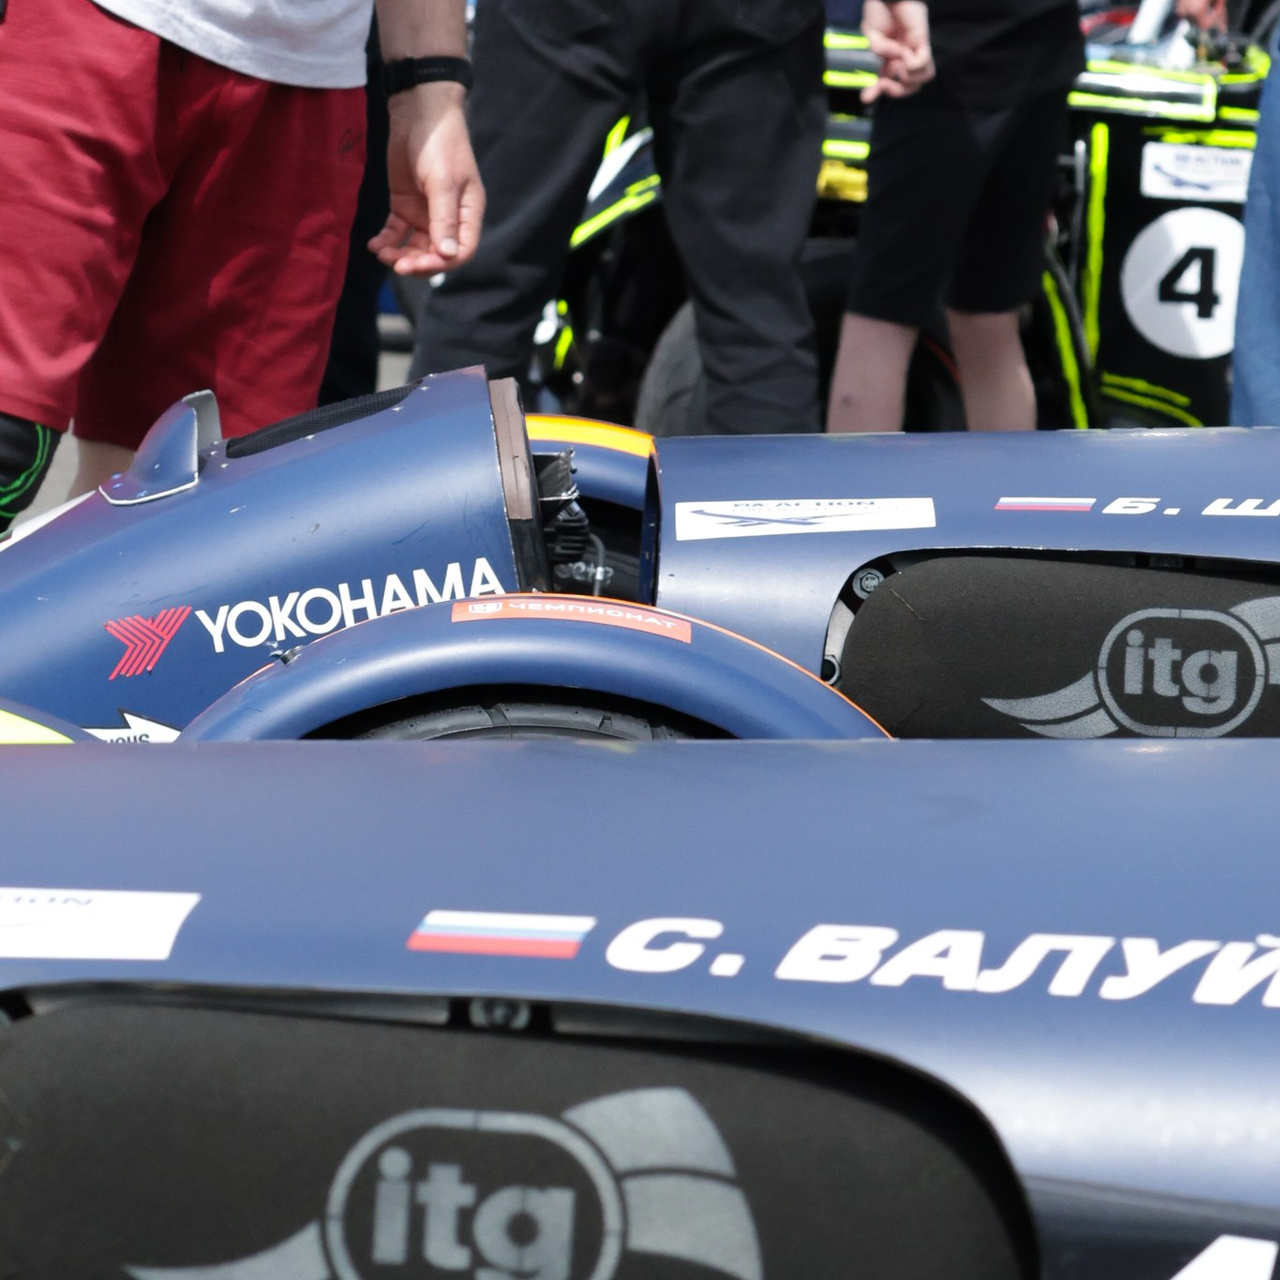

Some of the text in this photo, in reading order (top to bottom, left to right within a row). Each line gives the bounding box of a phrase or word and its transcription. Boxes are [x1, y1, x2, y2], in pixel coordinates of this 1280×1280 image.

[1158, 247, 1220, 320] 4
[1102, 497, 1182, 517] Б.
[195, 557, 506, 654] YOKOHAMA
[508, 602, 678, 629] ЧЕМПИОНАТ
[1122, 628, 1239, 715] itg
[604, 917, 746, 977] С.
